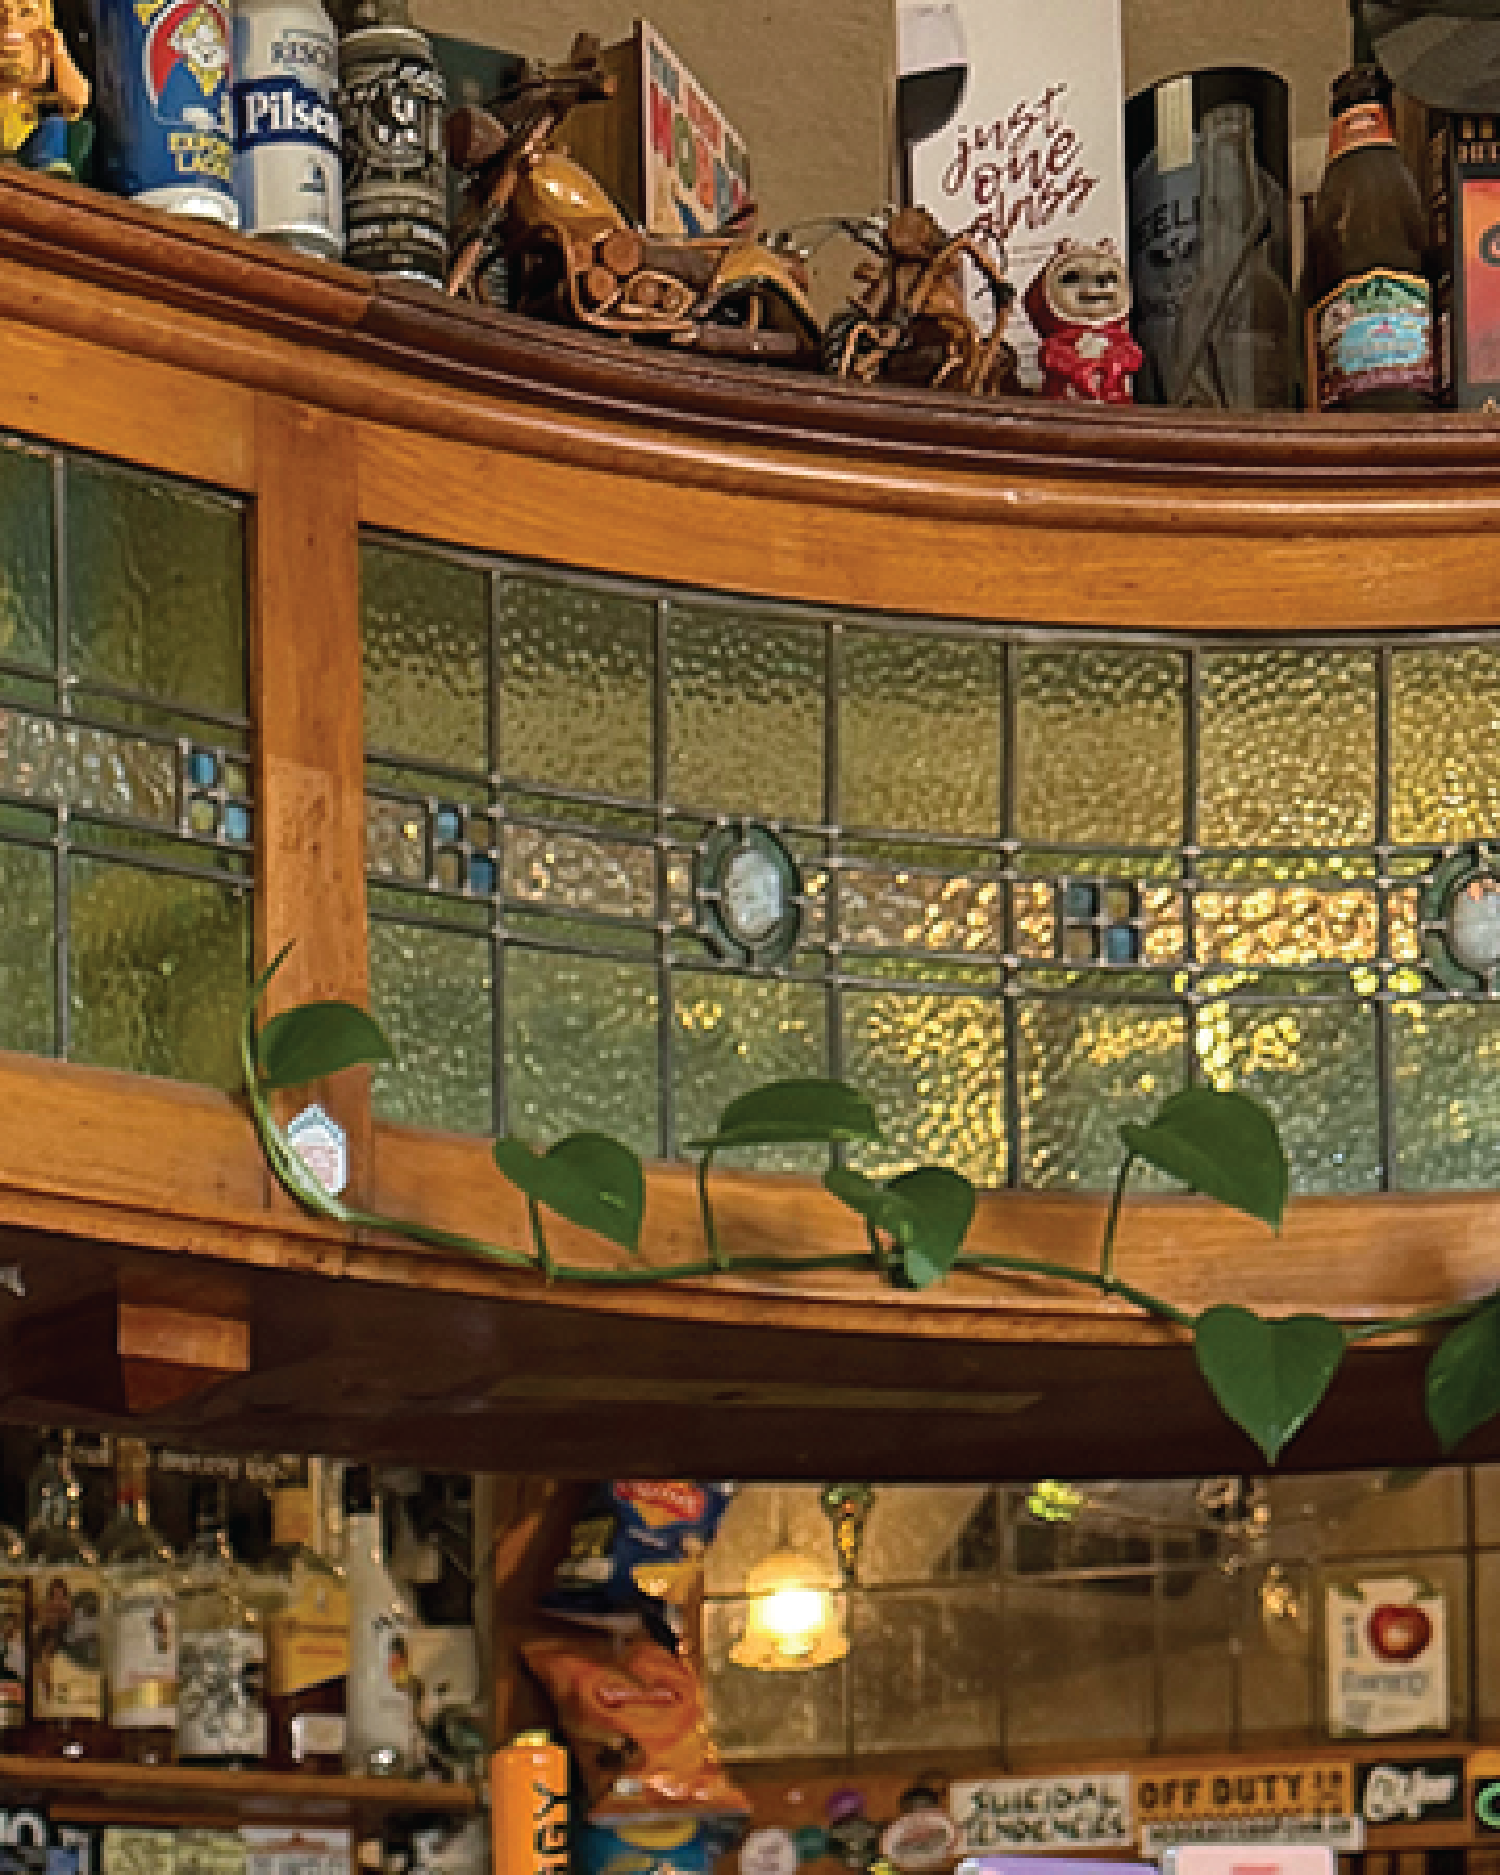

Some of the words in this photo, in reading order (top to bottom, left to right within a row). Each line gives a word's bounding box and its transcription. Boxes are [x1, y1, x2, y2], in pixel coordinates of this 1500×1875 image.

[942, 83, 1068, 195] just
[972, 126, 1082, 205] one
[970, 1786, 1119, 1817] SUICIDAL
[1138, 1781, 1200, 1810] OFF
[1211, 1775, 1306, 1805] DUTY
